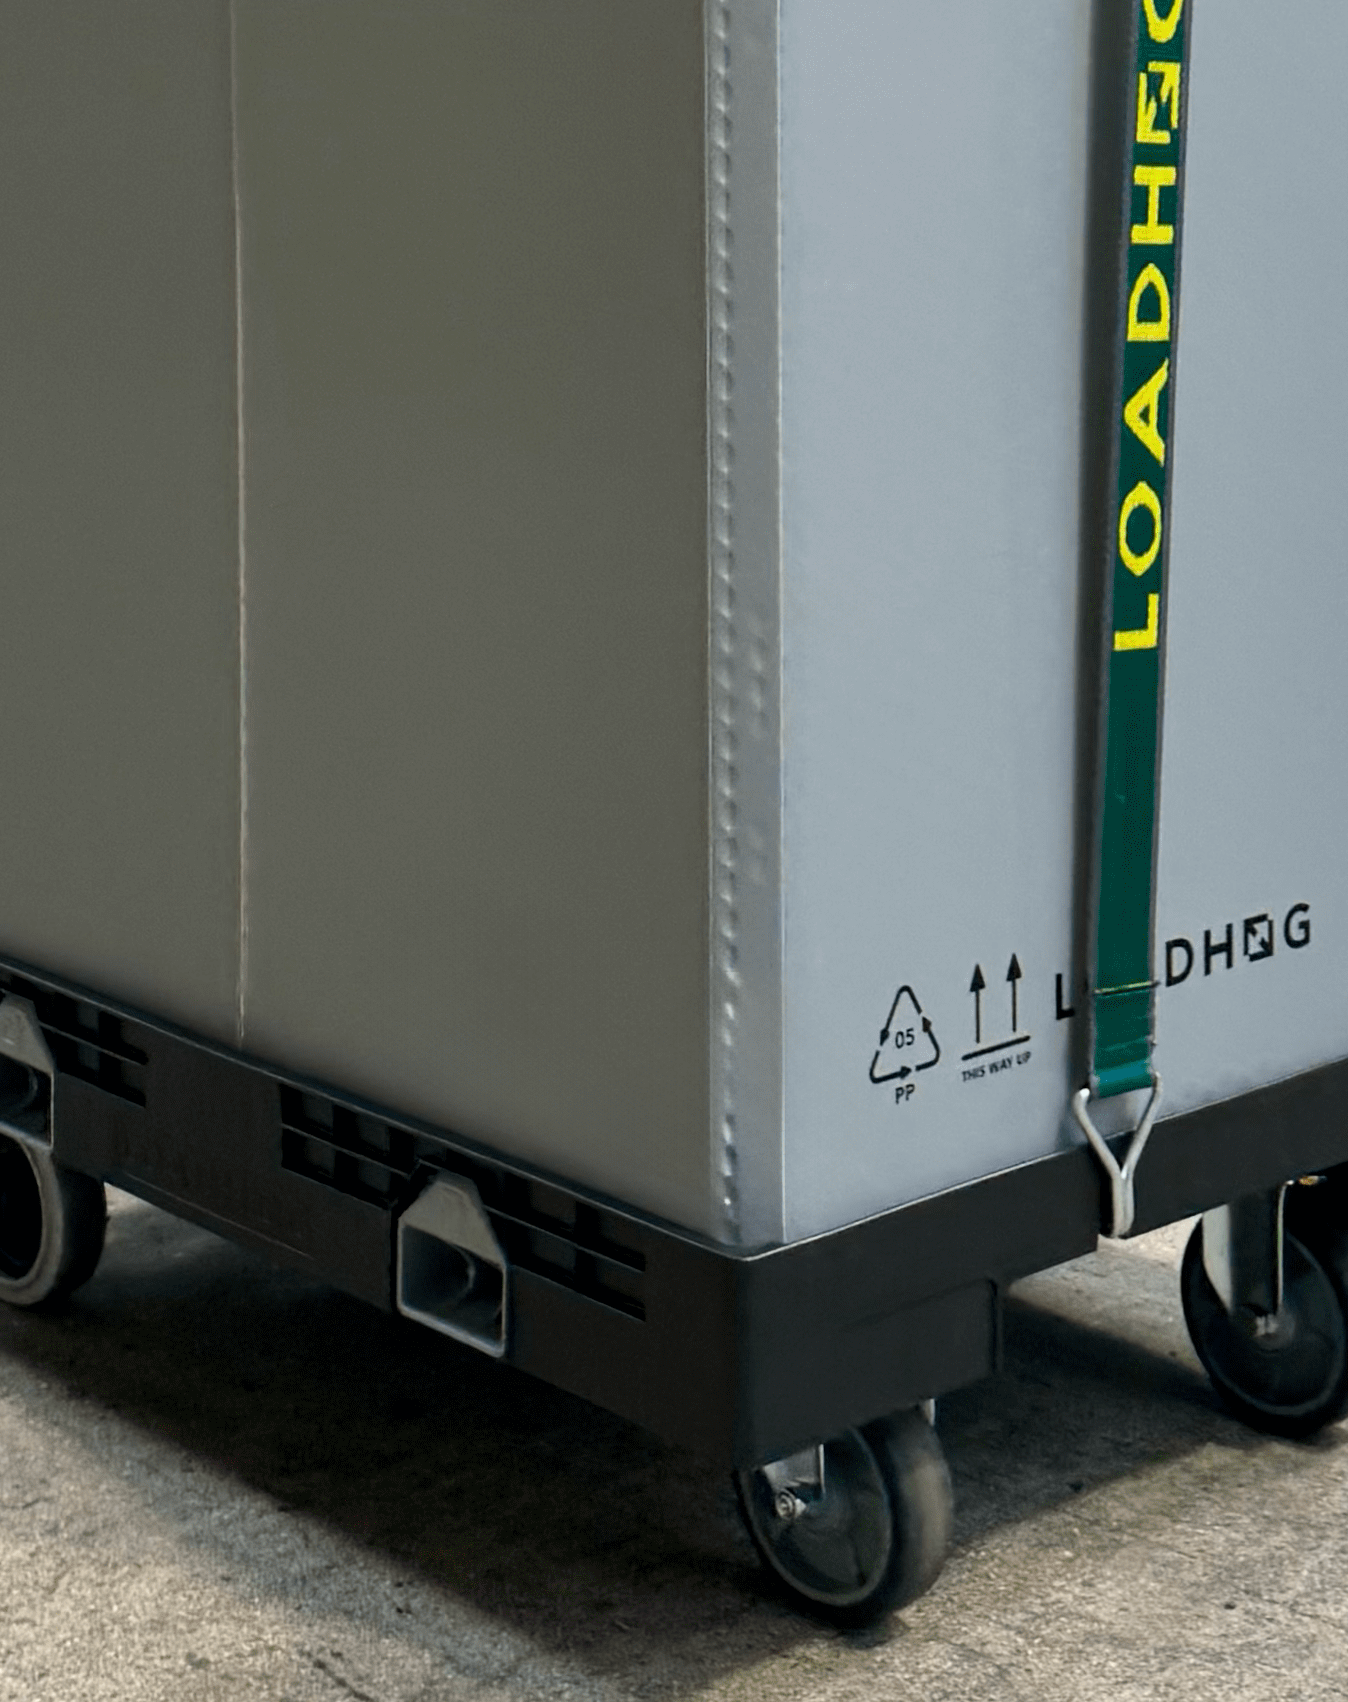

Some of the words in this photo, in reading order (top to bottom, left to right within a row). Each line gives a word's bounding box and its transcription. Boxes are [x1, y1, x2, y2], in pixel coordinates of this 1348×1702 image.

[1055, 902, 1310, 1021] LDHOG
[895, 1028, 915, 1049] 05
[962, 1065, 985, 1083] THIS
[989, 1055, 1013, 1074] WAY
[1016, 1051, 1031, 1065] UP
[895, 1084, 915, 1104] PP
